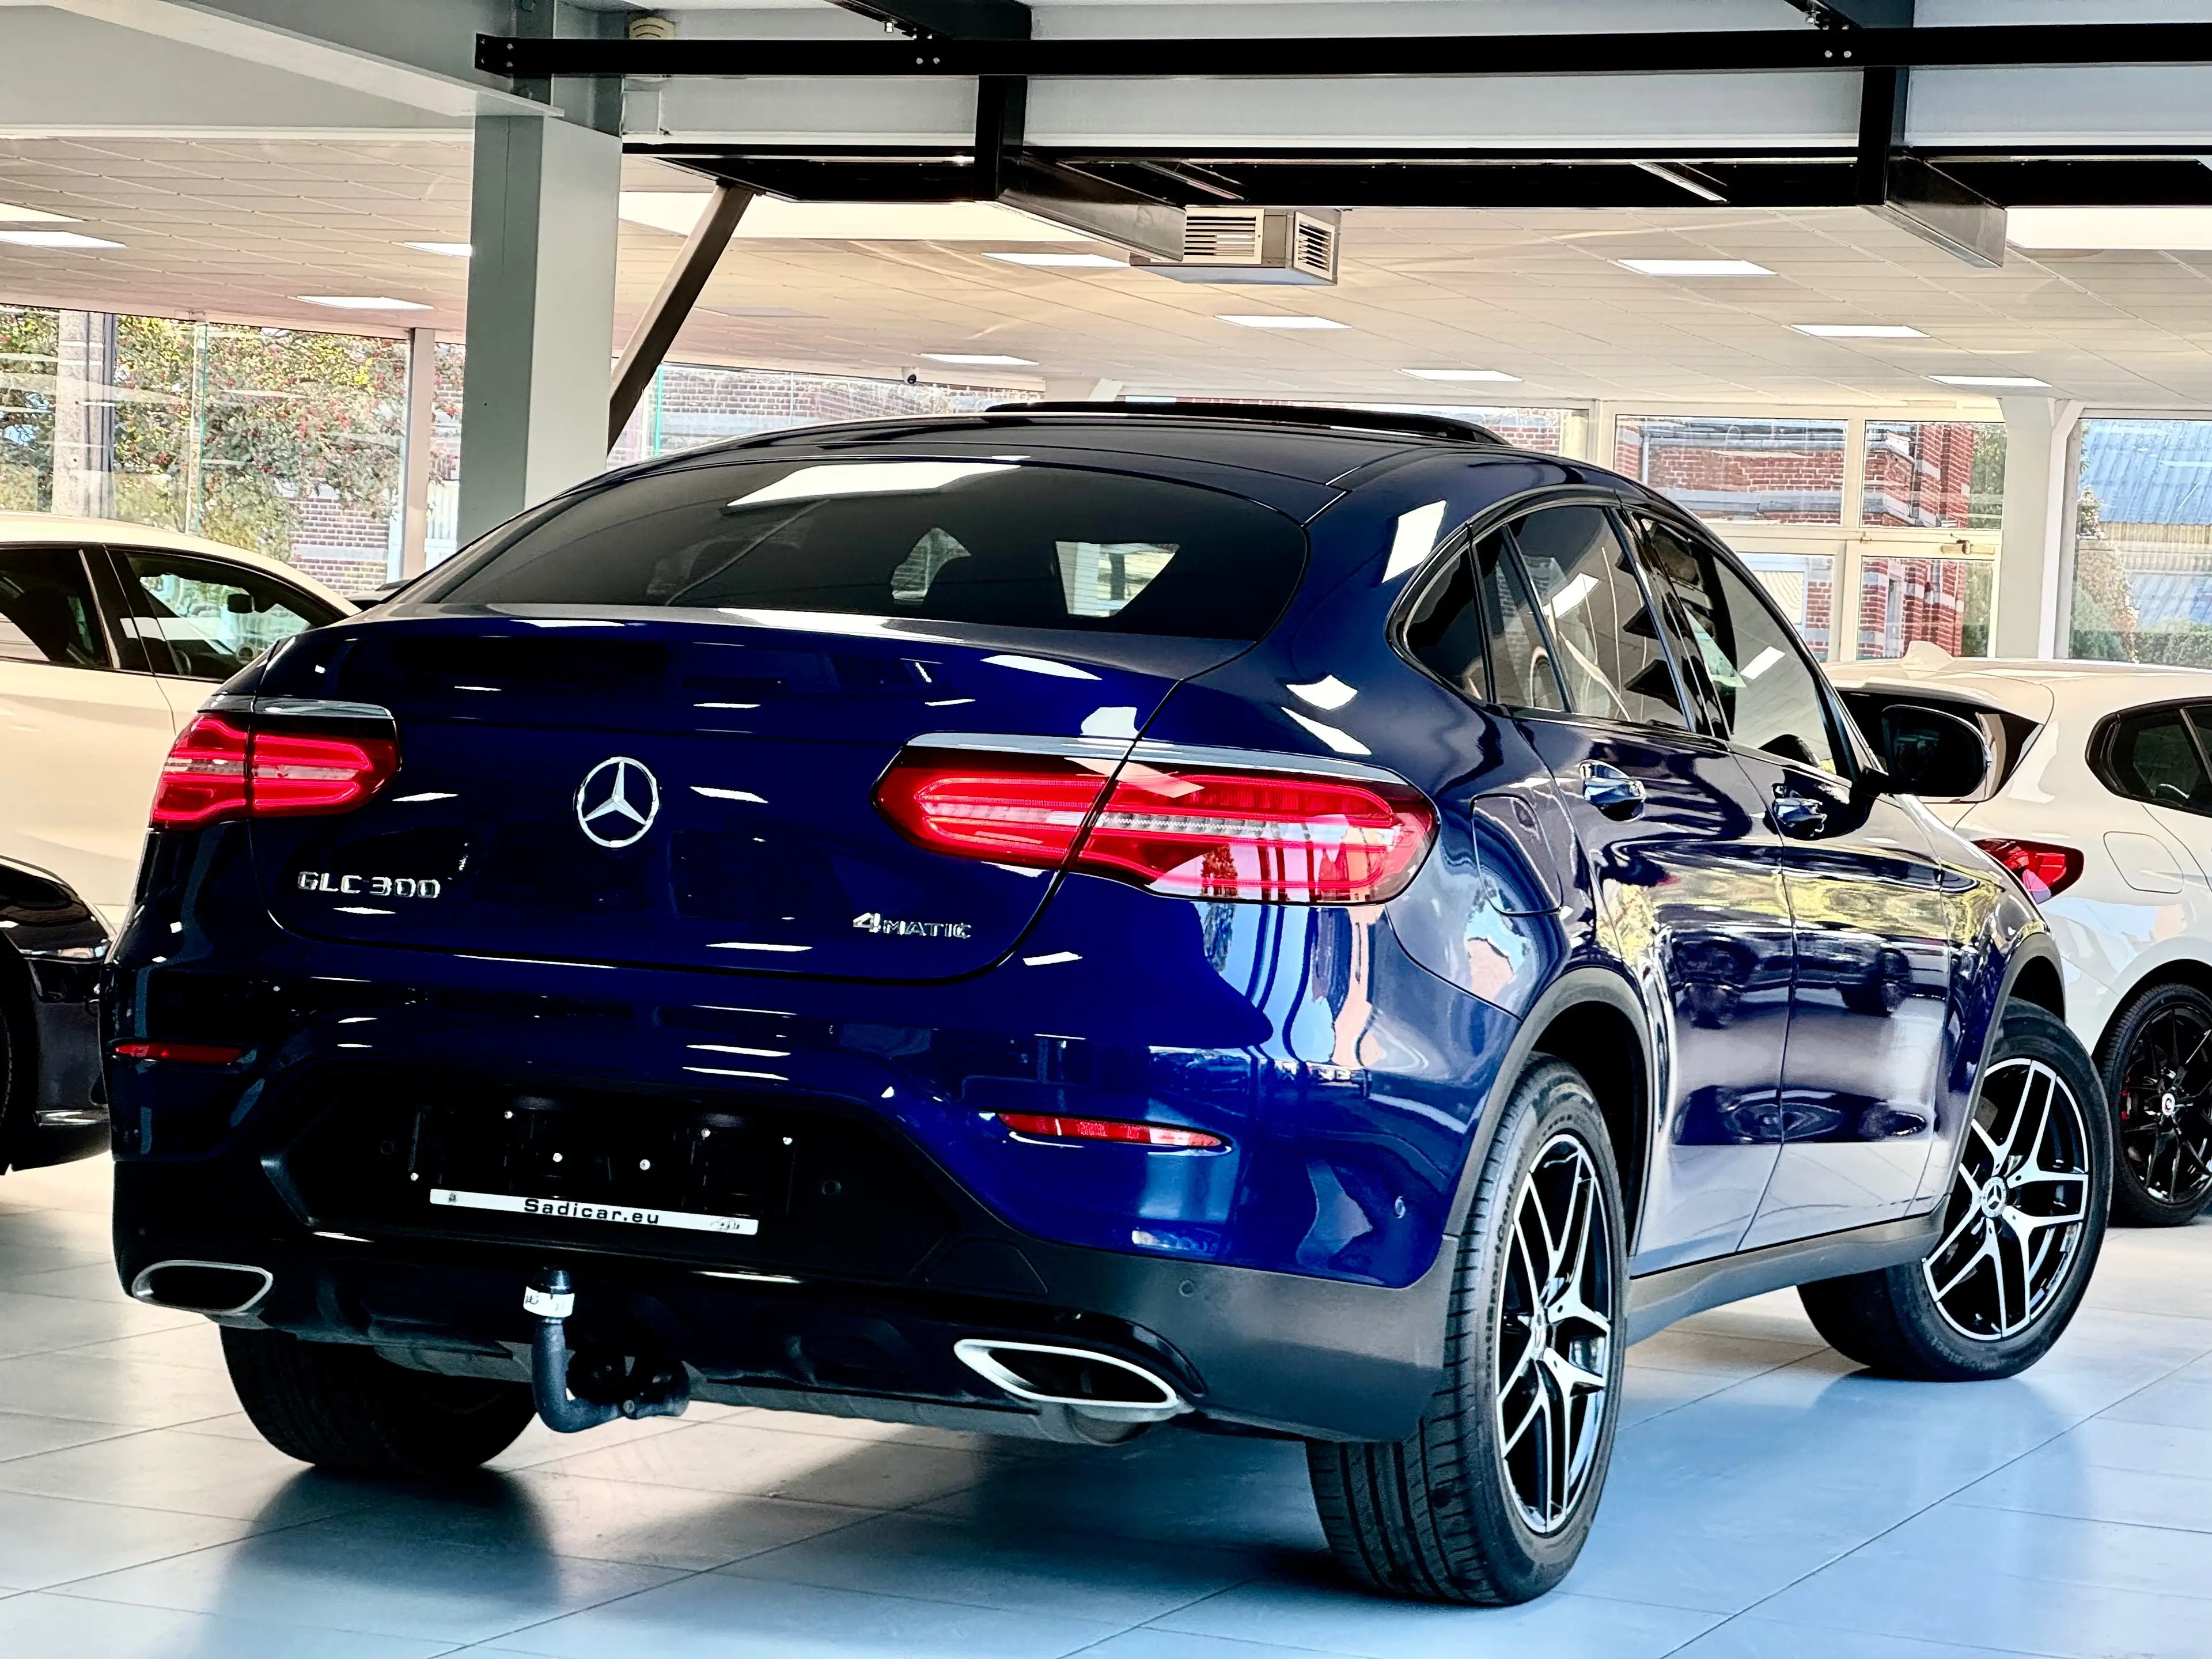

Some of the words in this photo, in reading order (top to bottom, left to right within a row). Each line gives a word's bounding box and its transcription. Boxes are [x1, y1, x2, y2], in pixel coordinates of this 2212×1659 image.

[298, 871, 362, 893] GLC
[369, 877, 441, 899] 300
[853, 912, 972, 939] 4MATIC
[524, 1198, 660, 1225] Sadicar.eu
